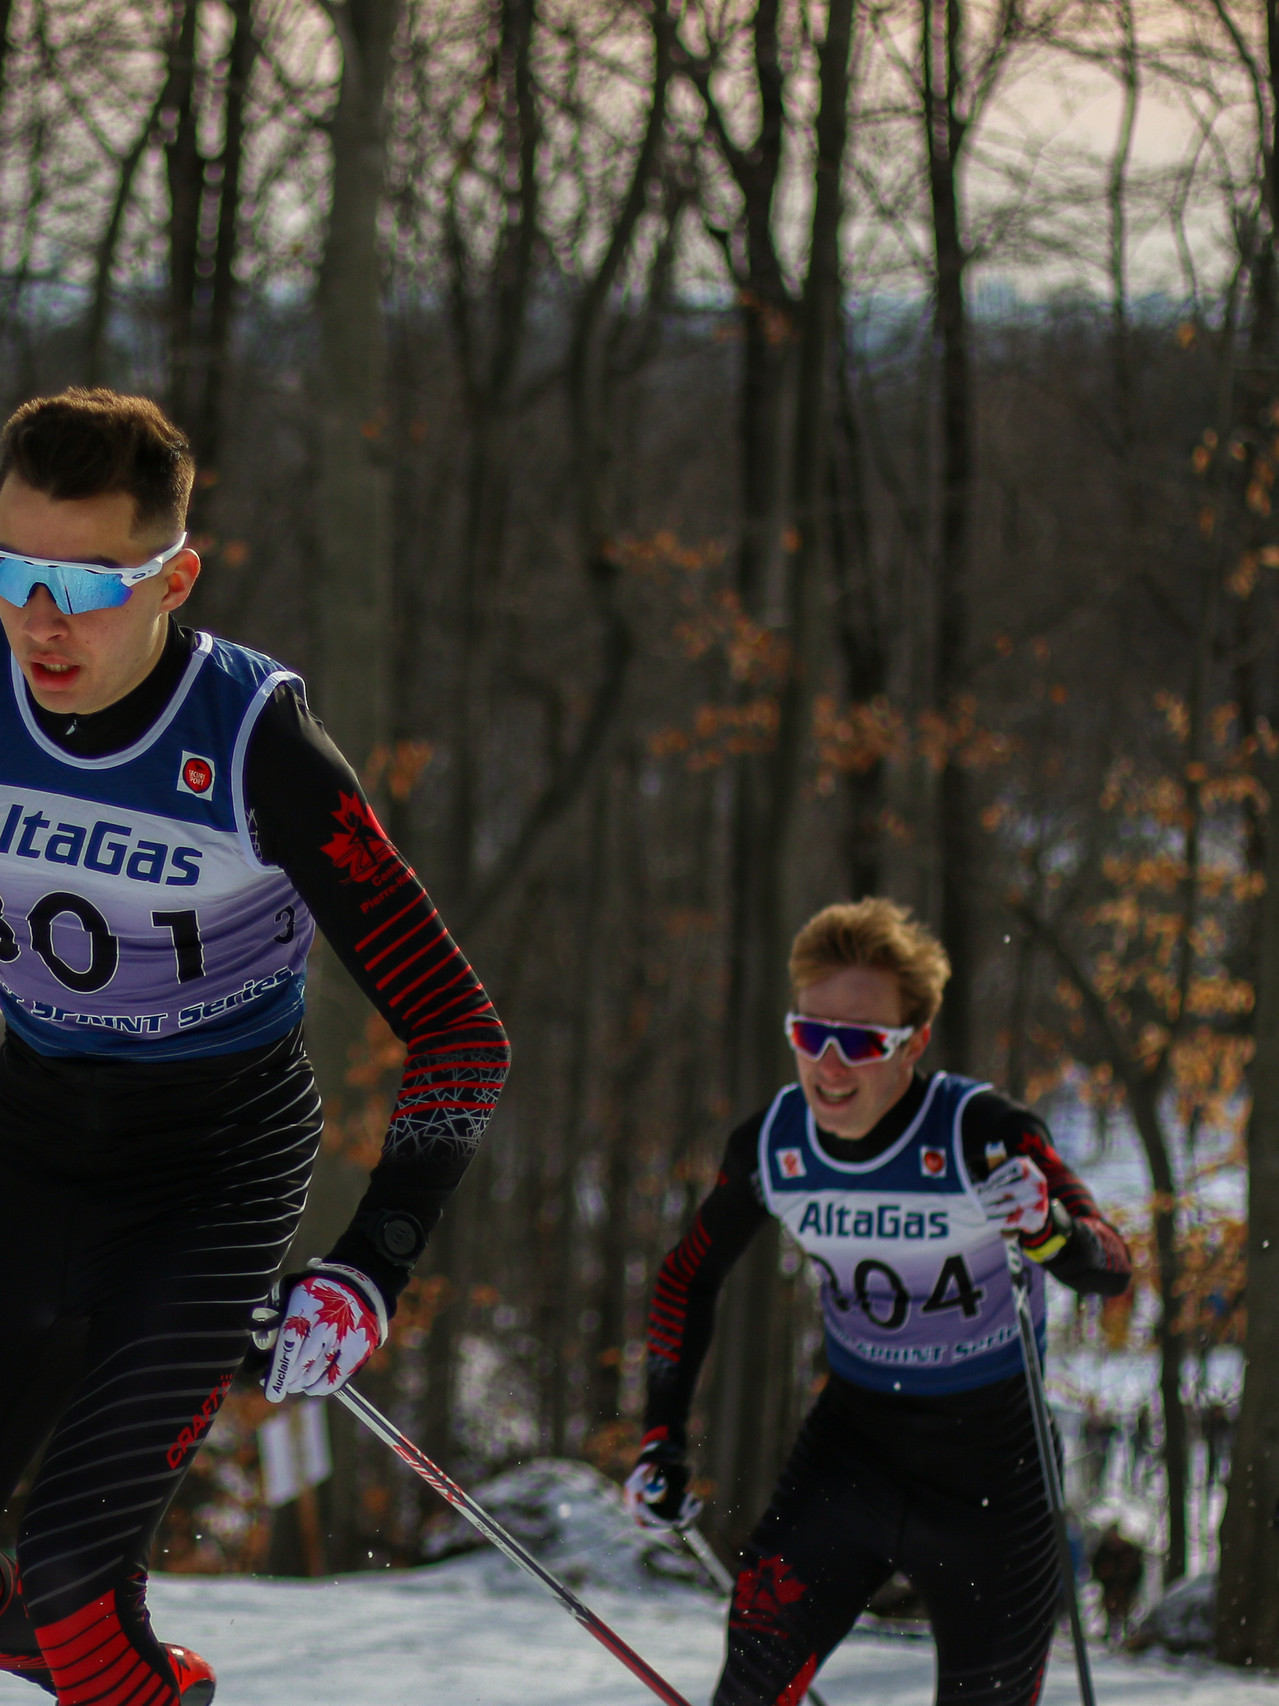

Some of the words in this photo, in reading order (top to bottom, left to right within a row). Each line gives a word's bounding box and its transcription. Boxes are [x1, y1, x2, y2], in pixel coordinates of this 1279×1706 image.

[178, 966, 294, 1029] Series
[798, 1201, 950, 1240] AltaGas
[272, 1354, 290, 1394] Auclair
[166, 1387, 219, 1469] CRAFT
